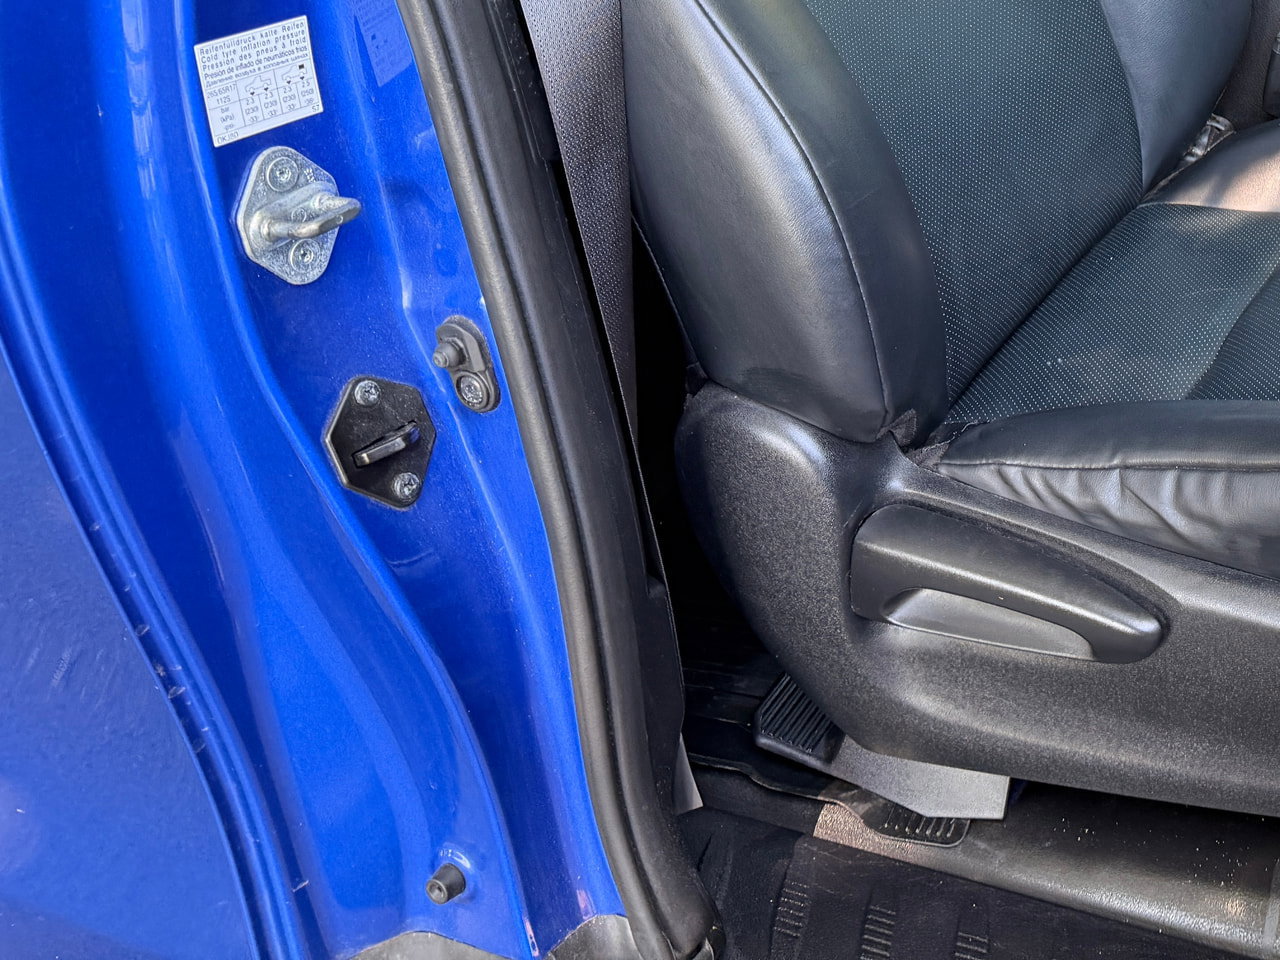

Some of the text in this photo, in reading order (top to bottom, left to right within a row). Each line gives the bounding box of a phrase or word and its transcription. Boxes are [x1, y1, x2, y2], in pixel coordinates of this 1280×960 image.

[260, 29, 277, 39] kalte
[281, 20, 304, 32] Reifen
[201, 29, 305, 64] Cold tyre inflation pressure
[202, 57, 235, 72] Pression
[239, 52, 252, 61] des
[256, 45, 278, 58] pneus
[289, 37, 306, 46] froid
[235, 60, 254, 71] inflado
